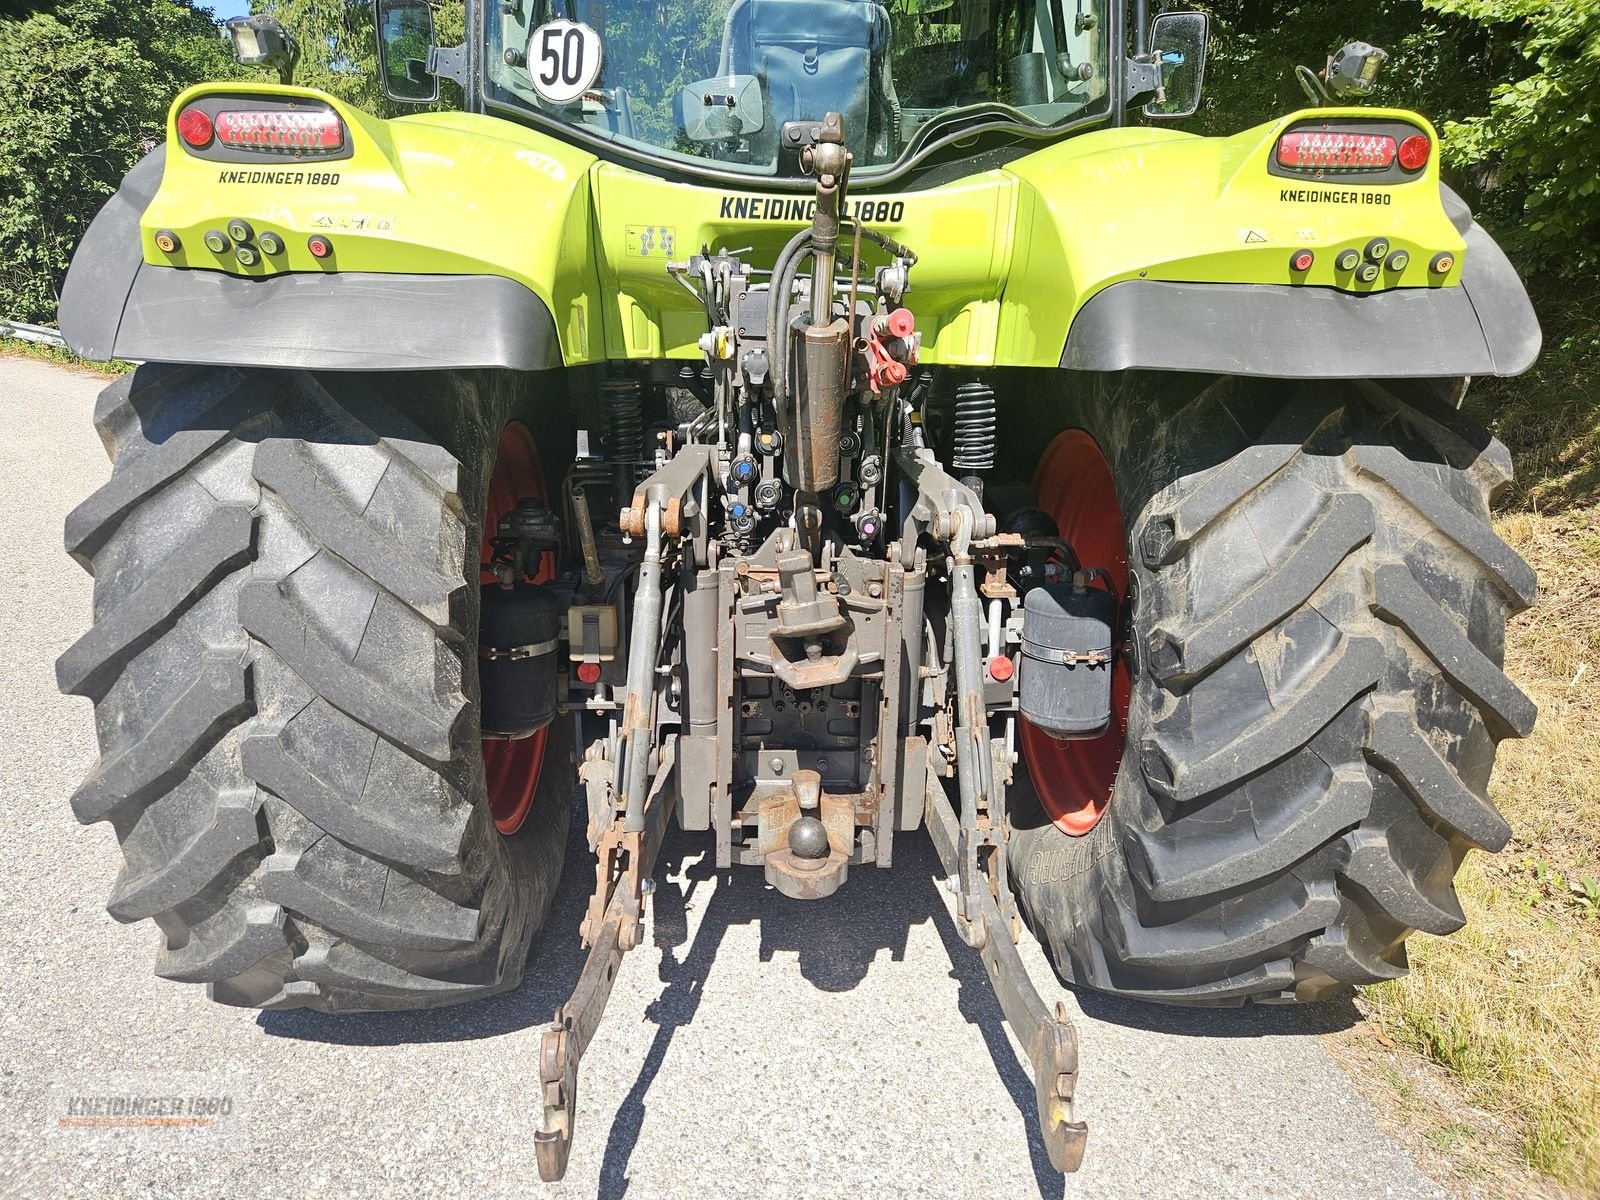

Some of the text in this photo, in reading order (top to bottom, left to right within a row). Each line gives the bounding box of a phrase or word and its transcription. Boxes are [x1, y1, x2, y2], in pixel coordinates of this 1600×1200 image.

[540, 28, 584, 86] 50
[219, 171, 340, 185] KNEIDINGER 1880
[1280, 190, 1391, 205] KNEIDINGER 1880
[720, 197, 904, 222] KNEIDING 1880
